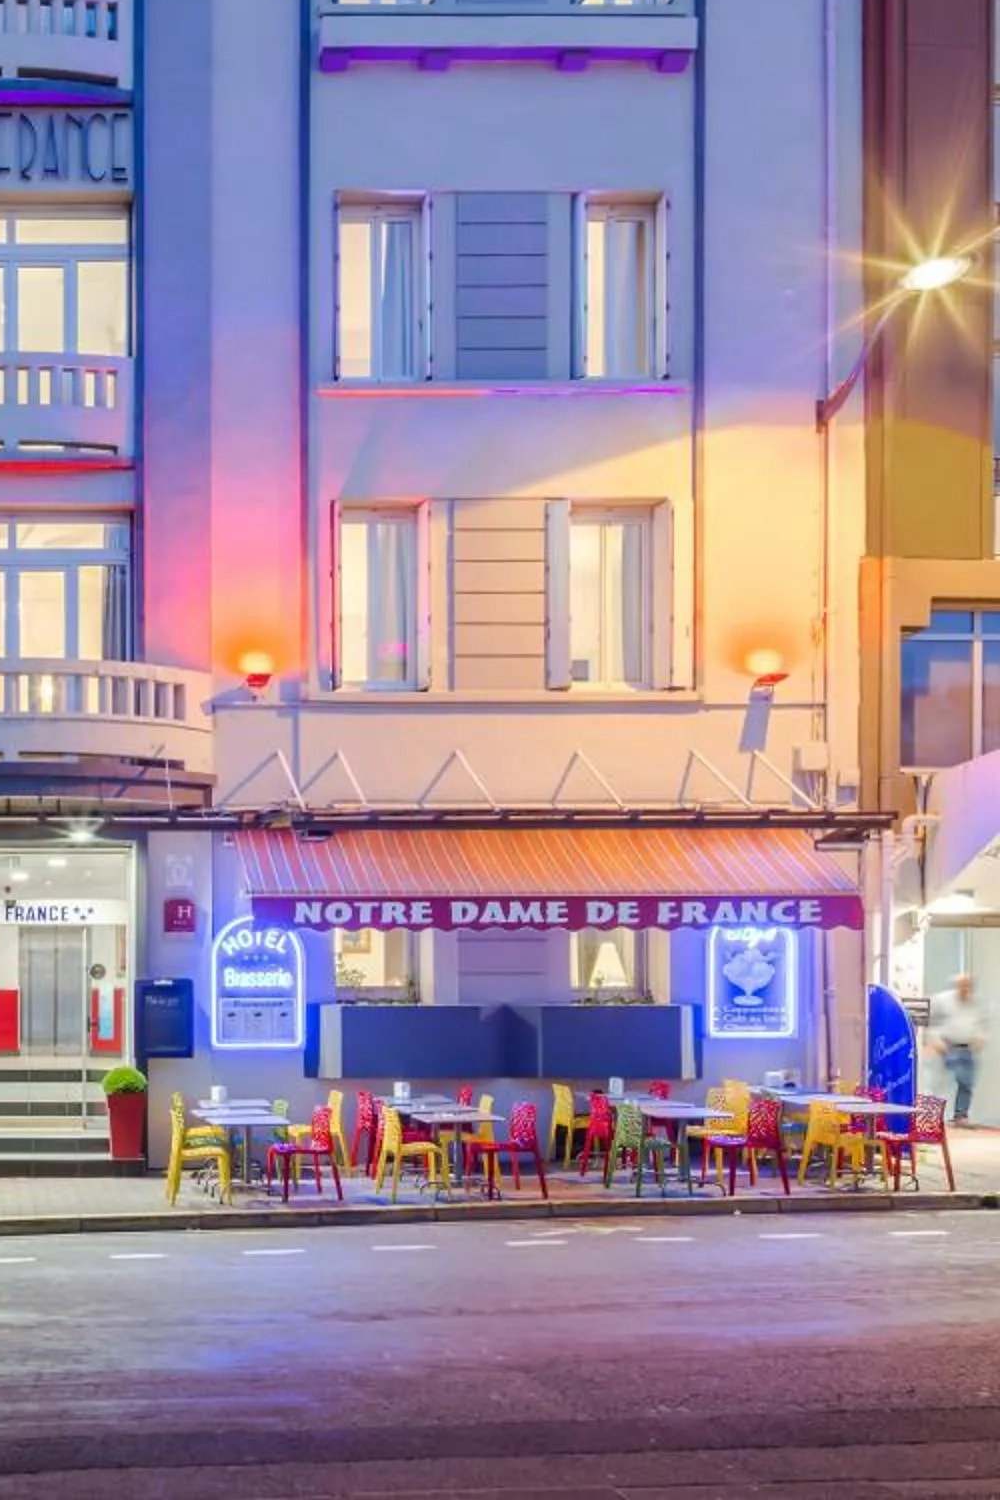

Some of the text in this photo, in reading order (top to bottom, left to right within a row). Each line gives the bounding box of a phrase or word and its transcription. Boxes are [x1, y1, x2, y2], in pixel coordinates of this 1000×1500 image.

[5, 904, 69, 922] FRANCE
[294, 899, 822, 925] NOTRE DAME DE FRANCE
[221, 929, 287, 956] HOTEL
[223, 966, 294, 989] Brasserie
